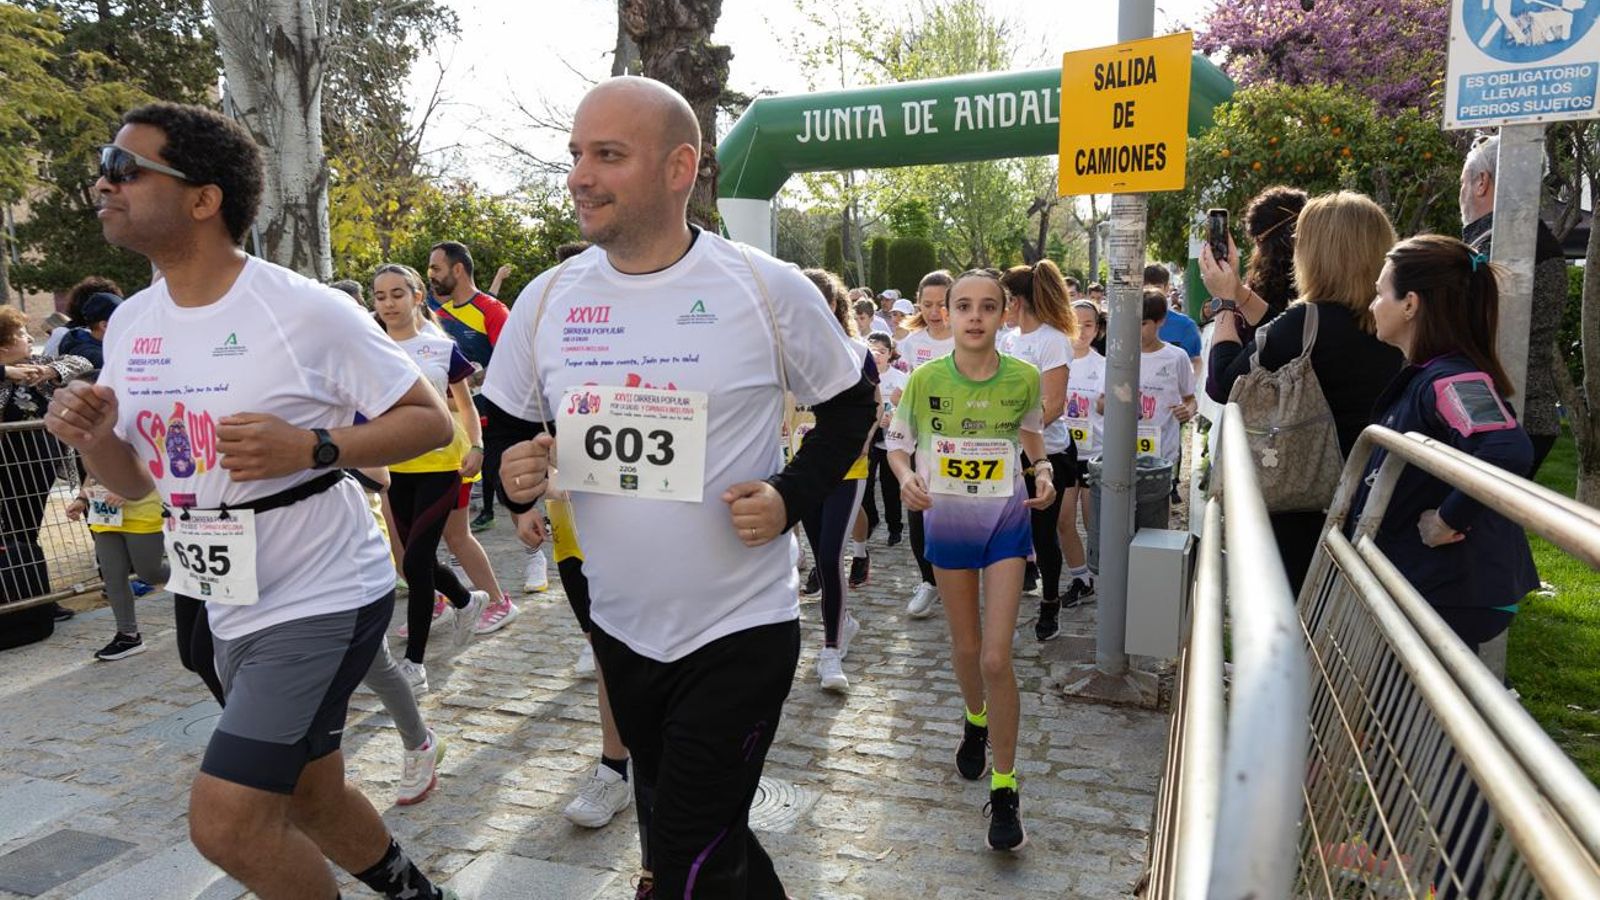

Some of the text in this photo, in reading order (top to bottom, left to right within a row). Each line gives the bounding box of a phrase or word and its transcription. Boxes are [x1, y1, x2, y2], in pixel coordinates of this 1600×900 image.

[1094, 55, 1157, 91] SALIDA
[1466, 65, 1591, 88] ES OBLIGATORIO
[1482, 82, 1572, 101] LLEVAR LOS
[796, 86, 1062, 143] JUNTA DE ANDAL
[1113, 101, 1135, 129] DE
[1460, 95, 1592, 117] PERROS SUJETOS
[1075, 142, 1166, 176] CAMIONES
[565, 306, 611, 324] XXVII
[131, 337, 163, 355] XXVII
[136, 409, 217, 479] SALUD
[585, 425, 675, 466] 603
[947, 458, 999, 480] 537
[173, 541, 231, 576] 635
